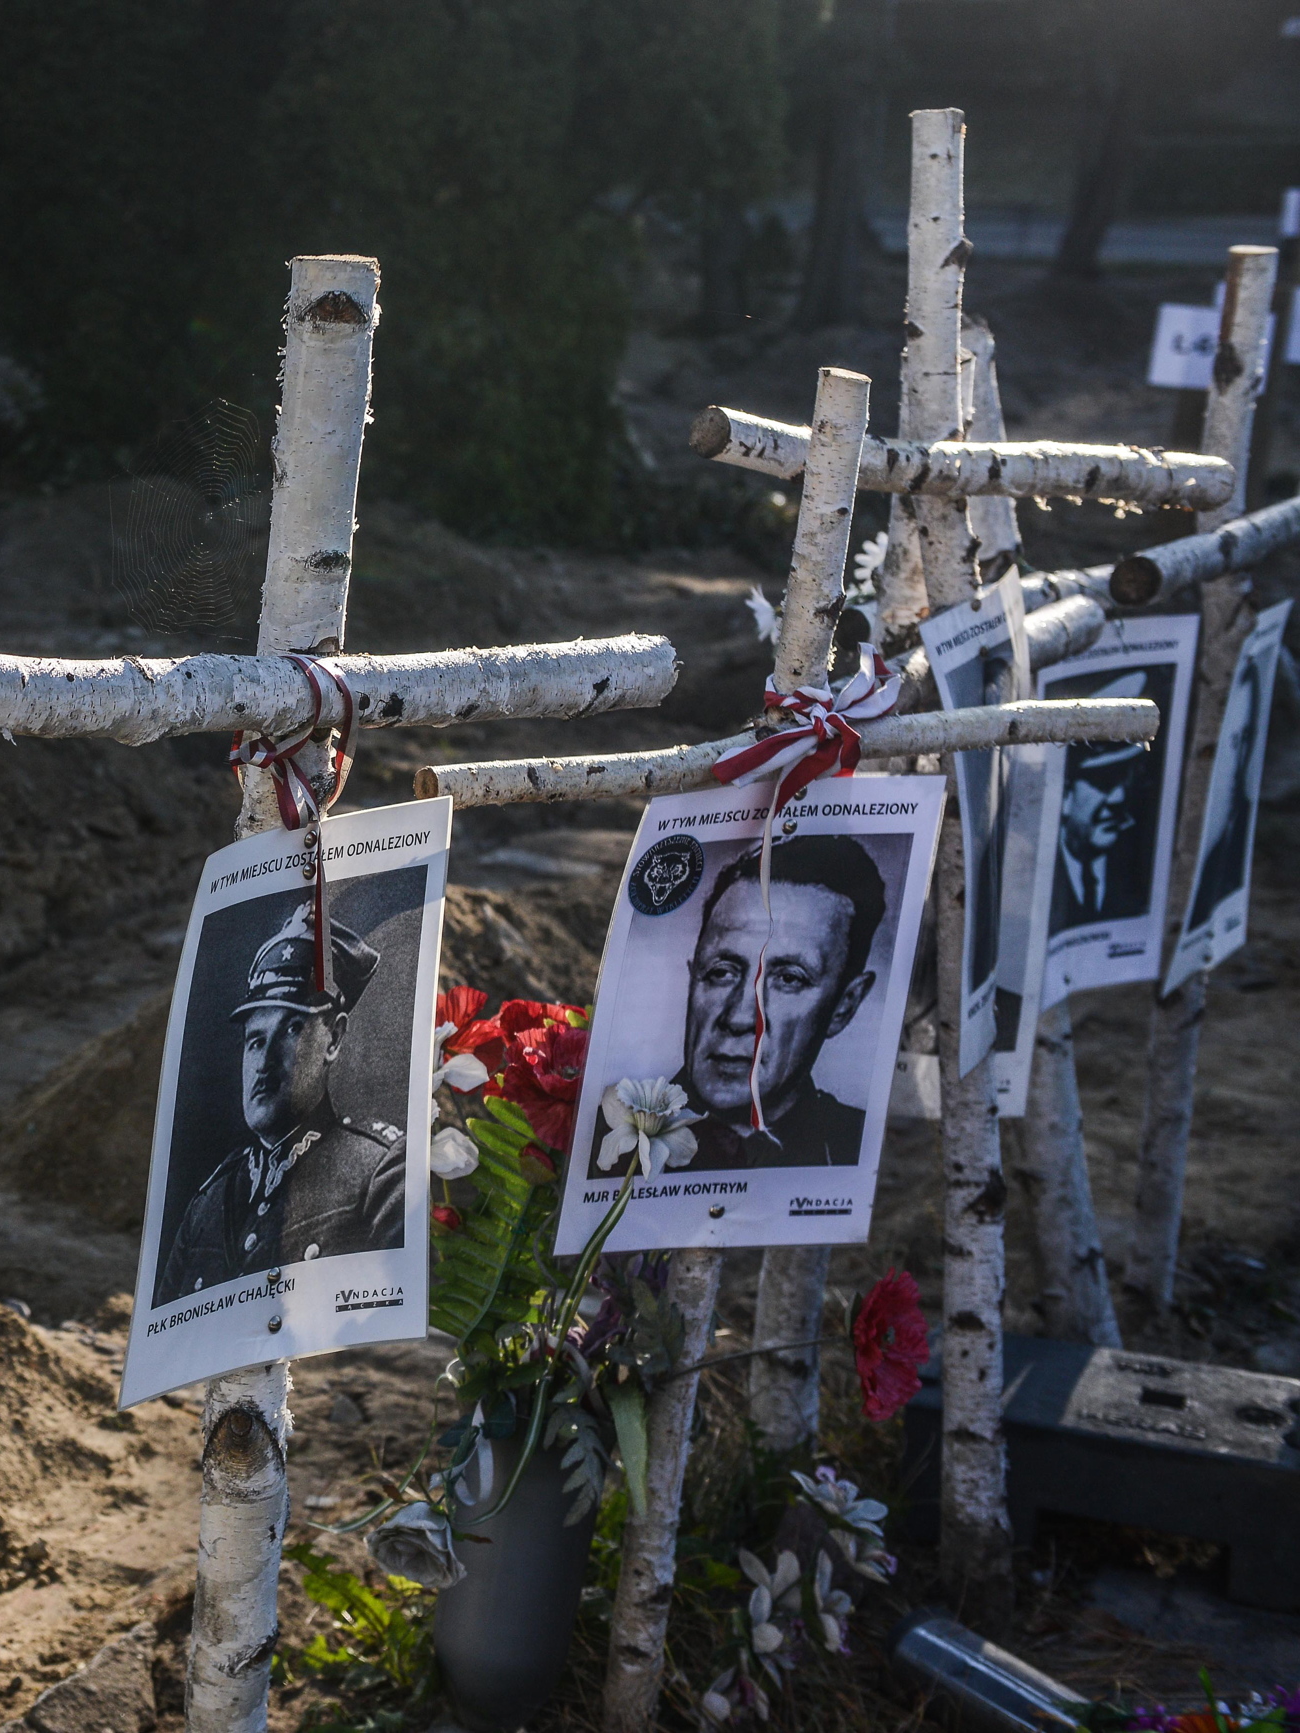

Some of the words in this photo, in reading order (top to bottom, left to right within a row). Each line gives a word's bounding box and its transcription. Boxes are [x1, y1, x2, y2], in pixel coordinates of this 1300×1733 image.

[657, 819, 672, 831] W
[671, 814, 698, 828] TYM
[698, 809, 750, 826] MIEJSCU
[753, 803, 819, 821] ZOTAŁEM
[821, 802, 919, 817] ODNALEZIONY
[209, 880, 221, 894] W
[219, 873, 239, 890] TYM
[239, 857, 283, 882] MIEJSCU
[347, 830, 432, 858] ODNALEZIONY
[582, 1189, 610, 1204] MJR
[612, 1184, 681, 1202] BLESŁAW
[683, 1181, 749, 1196] KONTRYM
[146, 1318, 168, 1338] PŁK
[168, 1292, 237, 1329] BRONISŁAW
[237, 1277, 296, 1304] CHAJĘCKI
